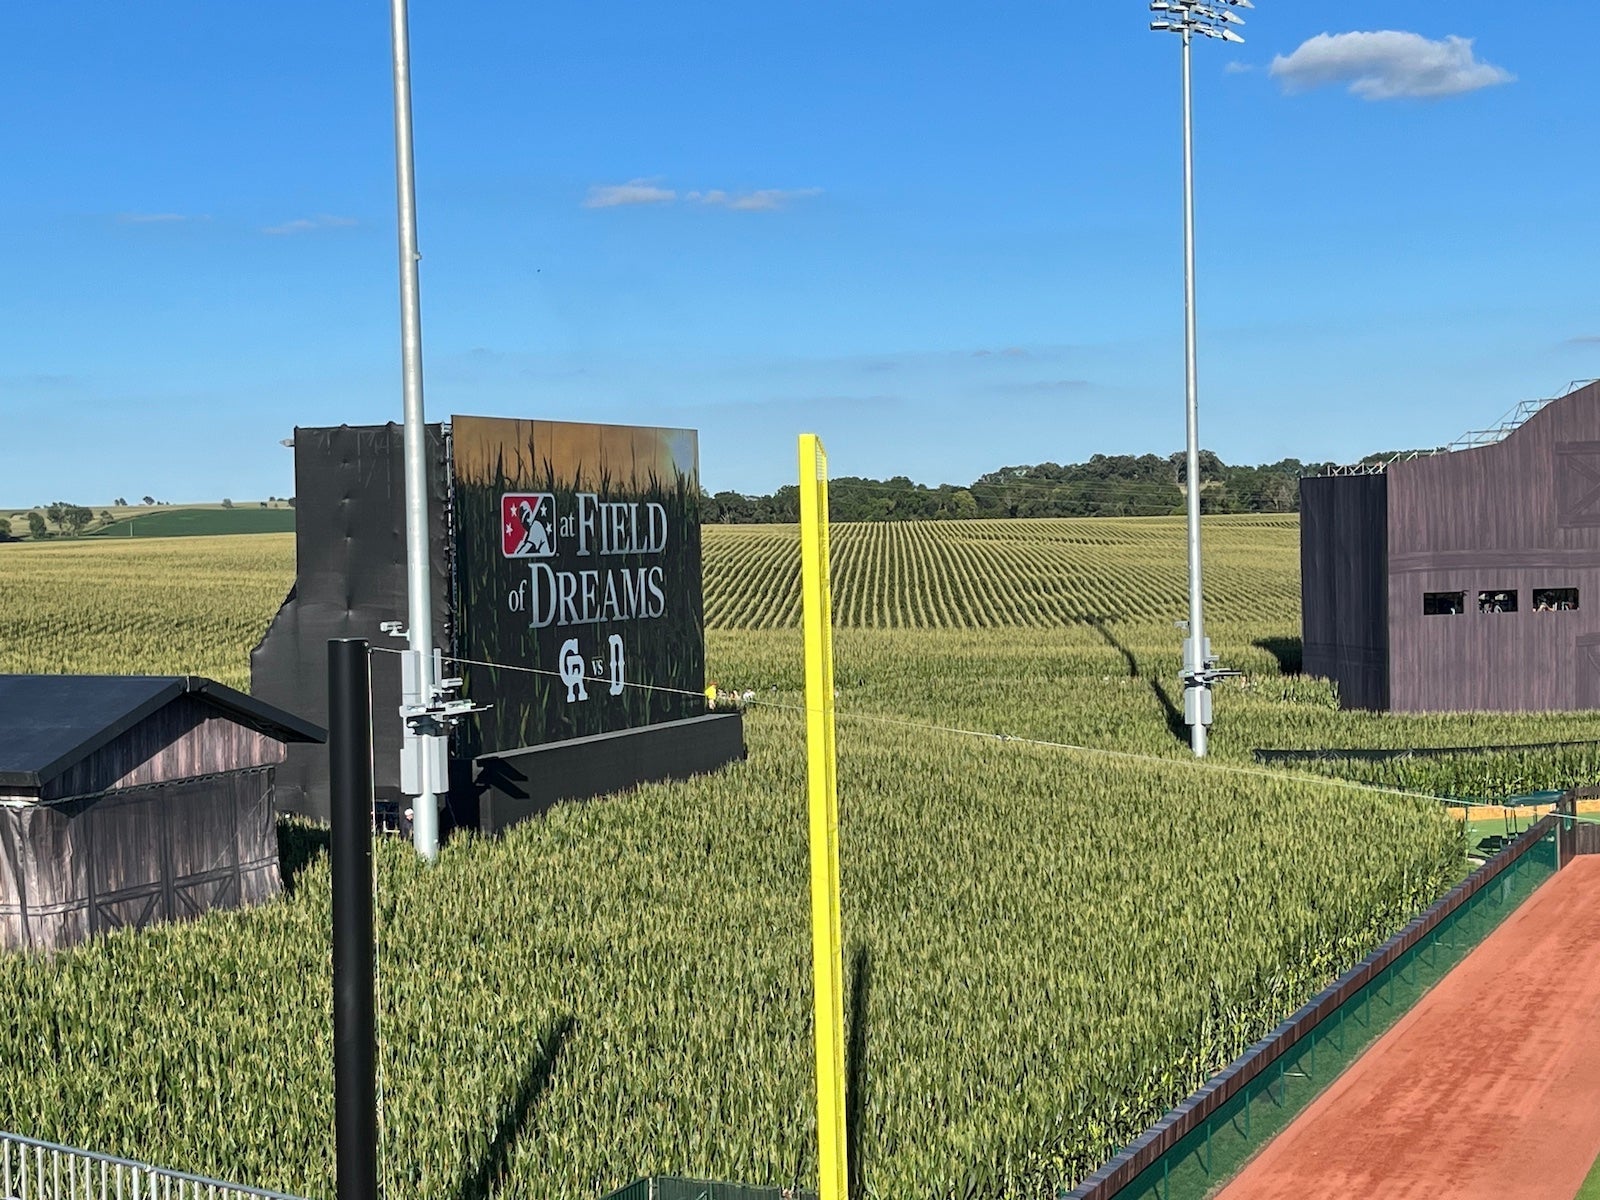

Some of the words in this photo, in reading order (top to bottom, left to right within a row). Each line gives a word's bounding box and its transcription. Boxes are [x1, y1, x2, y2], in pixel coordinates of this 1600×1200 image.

[560, 514, 575, 537] at
[575, 492, 668, 556] FIELD
[508, 579, 527, 613] of
[528, 562, 665, 629] DREAMS
